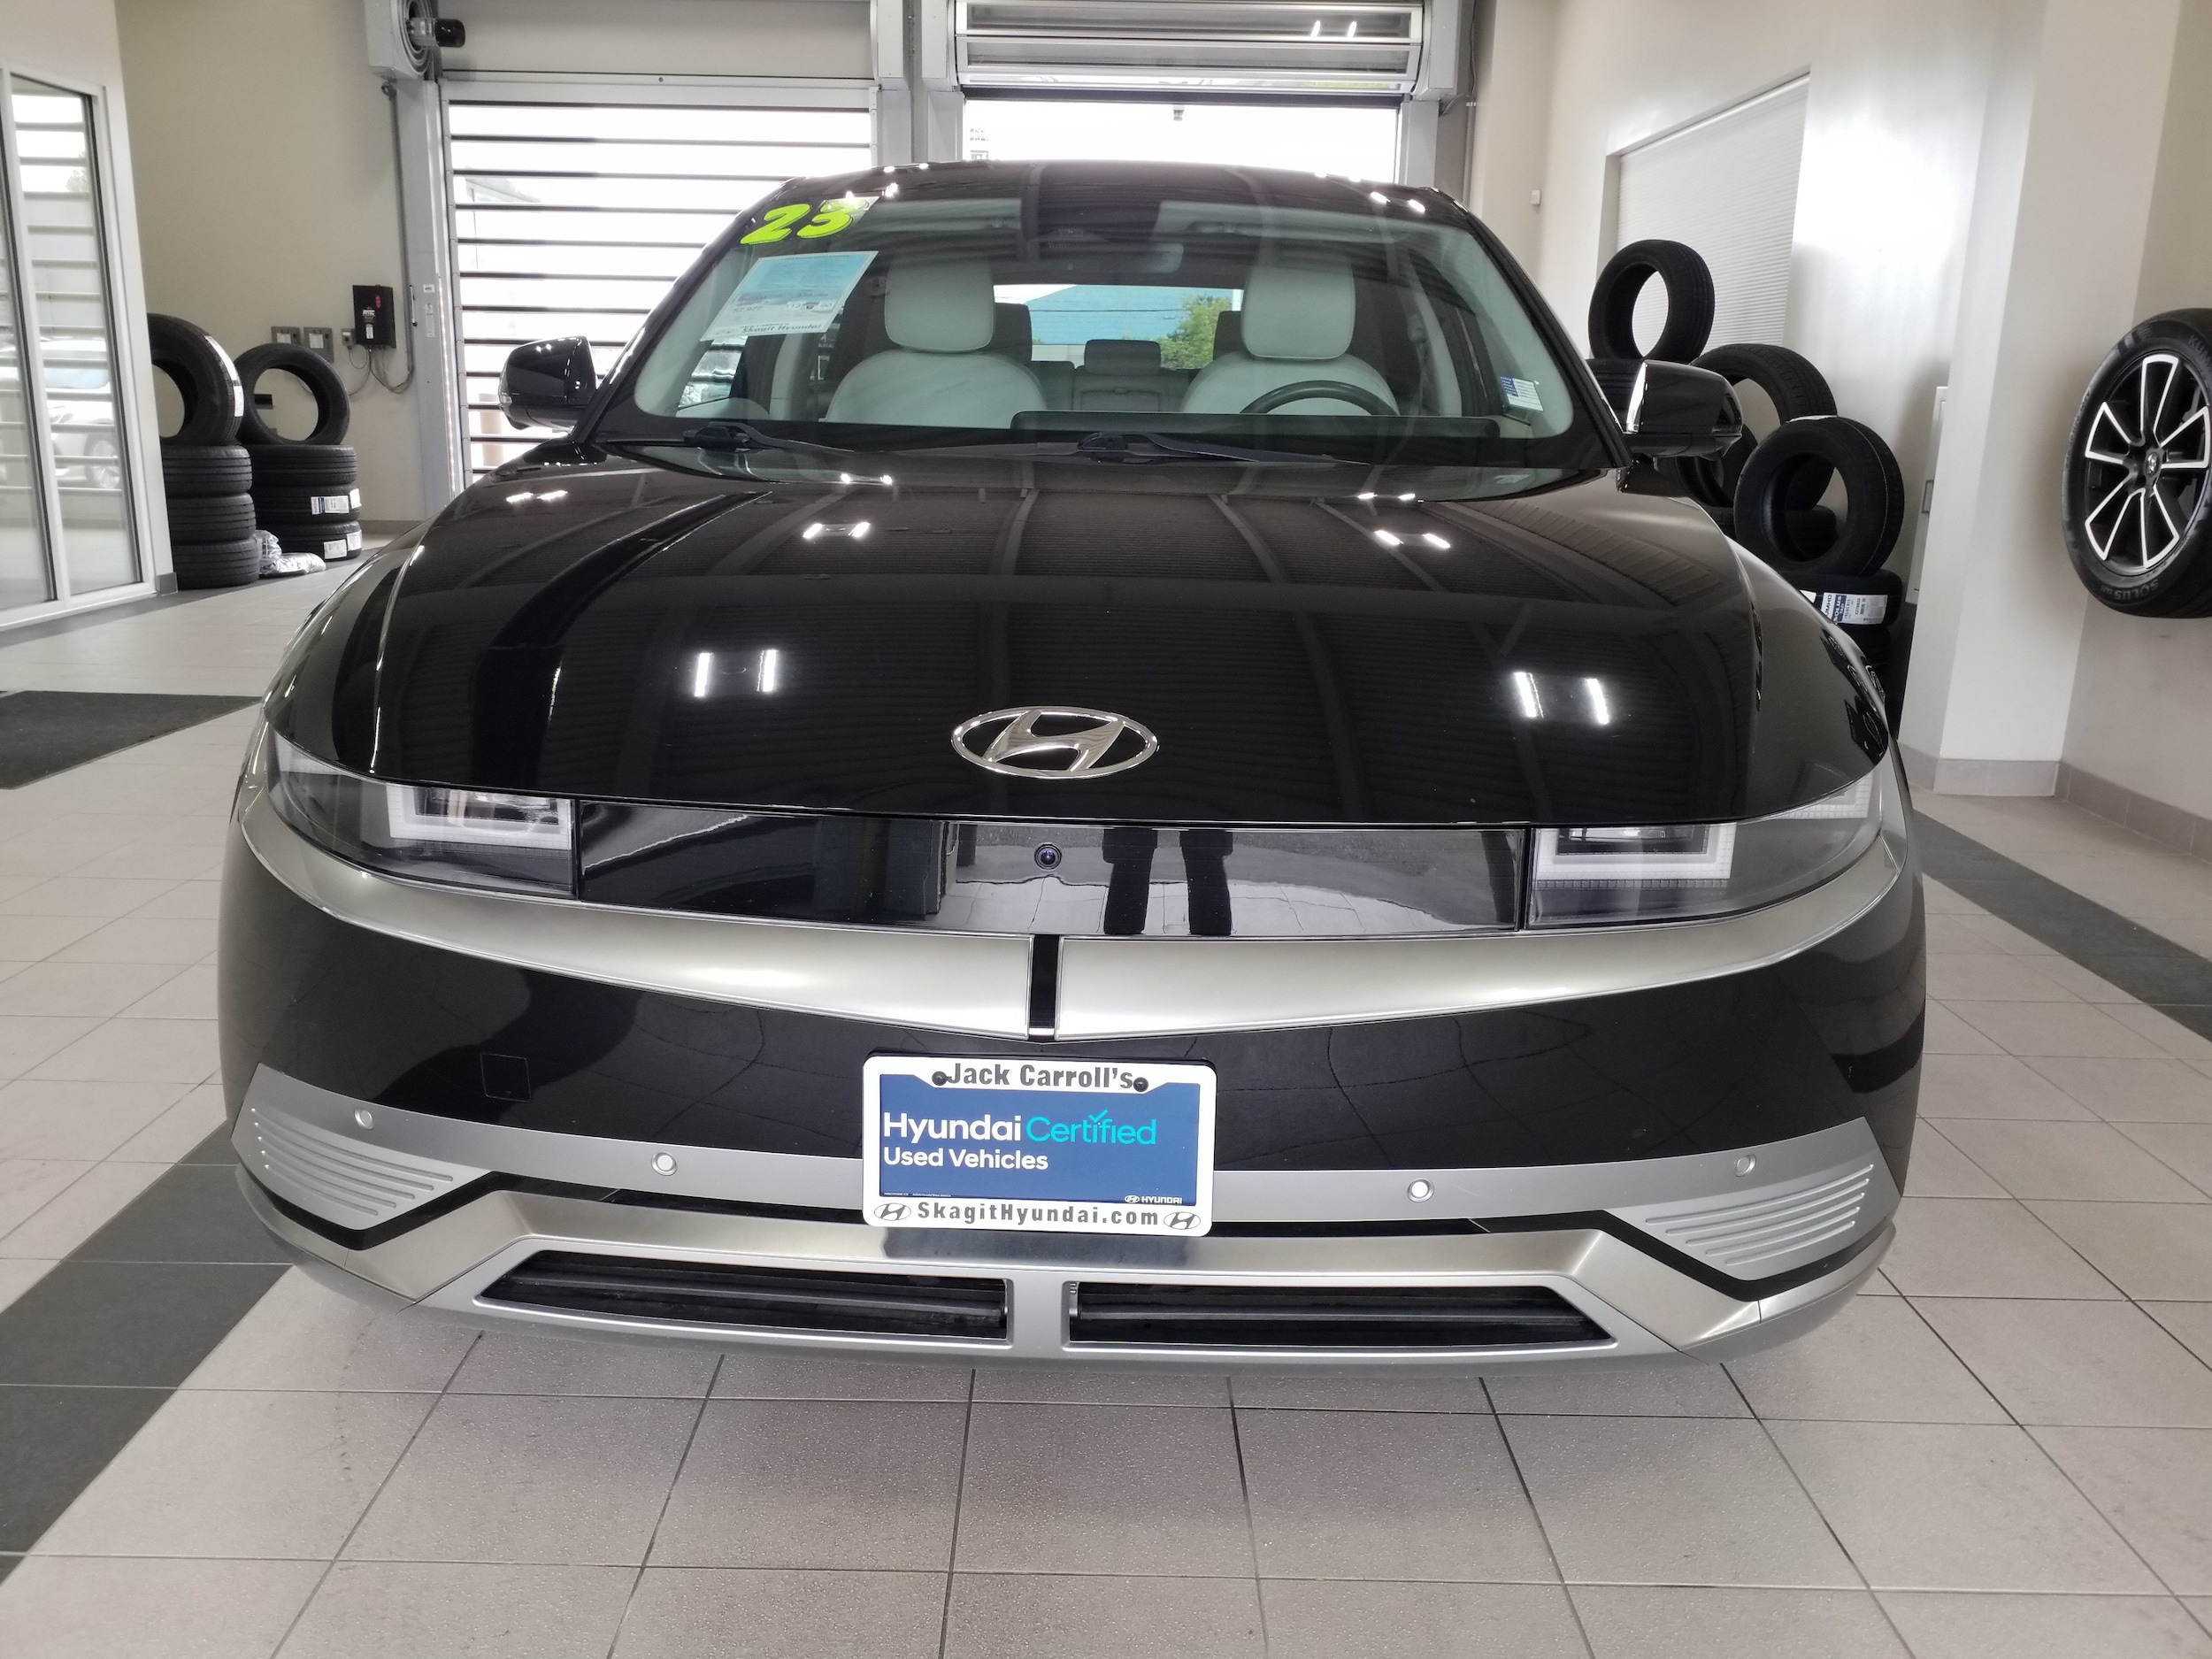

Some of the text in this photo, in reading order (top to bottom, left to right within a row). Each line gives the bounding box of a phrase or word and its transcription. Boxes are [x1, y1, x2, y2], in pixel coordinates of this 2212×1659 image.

[741, 200, 869, 245] 23
[946, 1063, 1133, 1088] Jack Carroll's
[884, 1110, 1156, 1145] Hyundai Certified
[884, 1147, 1049, 1171] Used Vehicles
[1141, 1195, 1183, 1204] HYUNDAI
[918, 1201, 1158, 1225] SkagitHyundai.com
